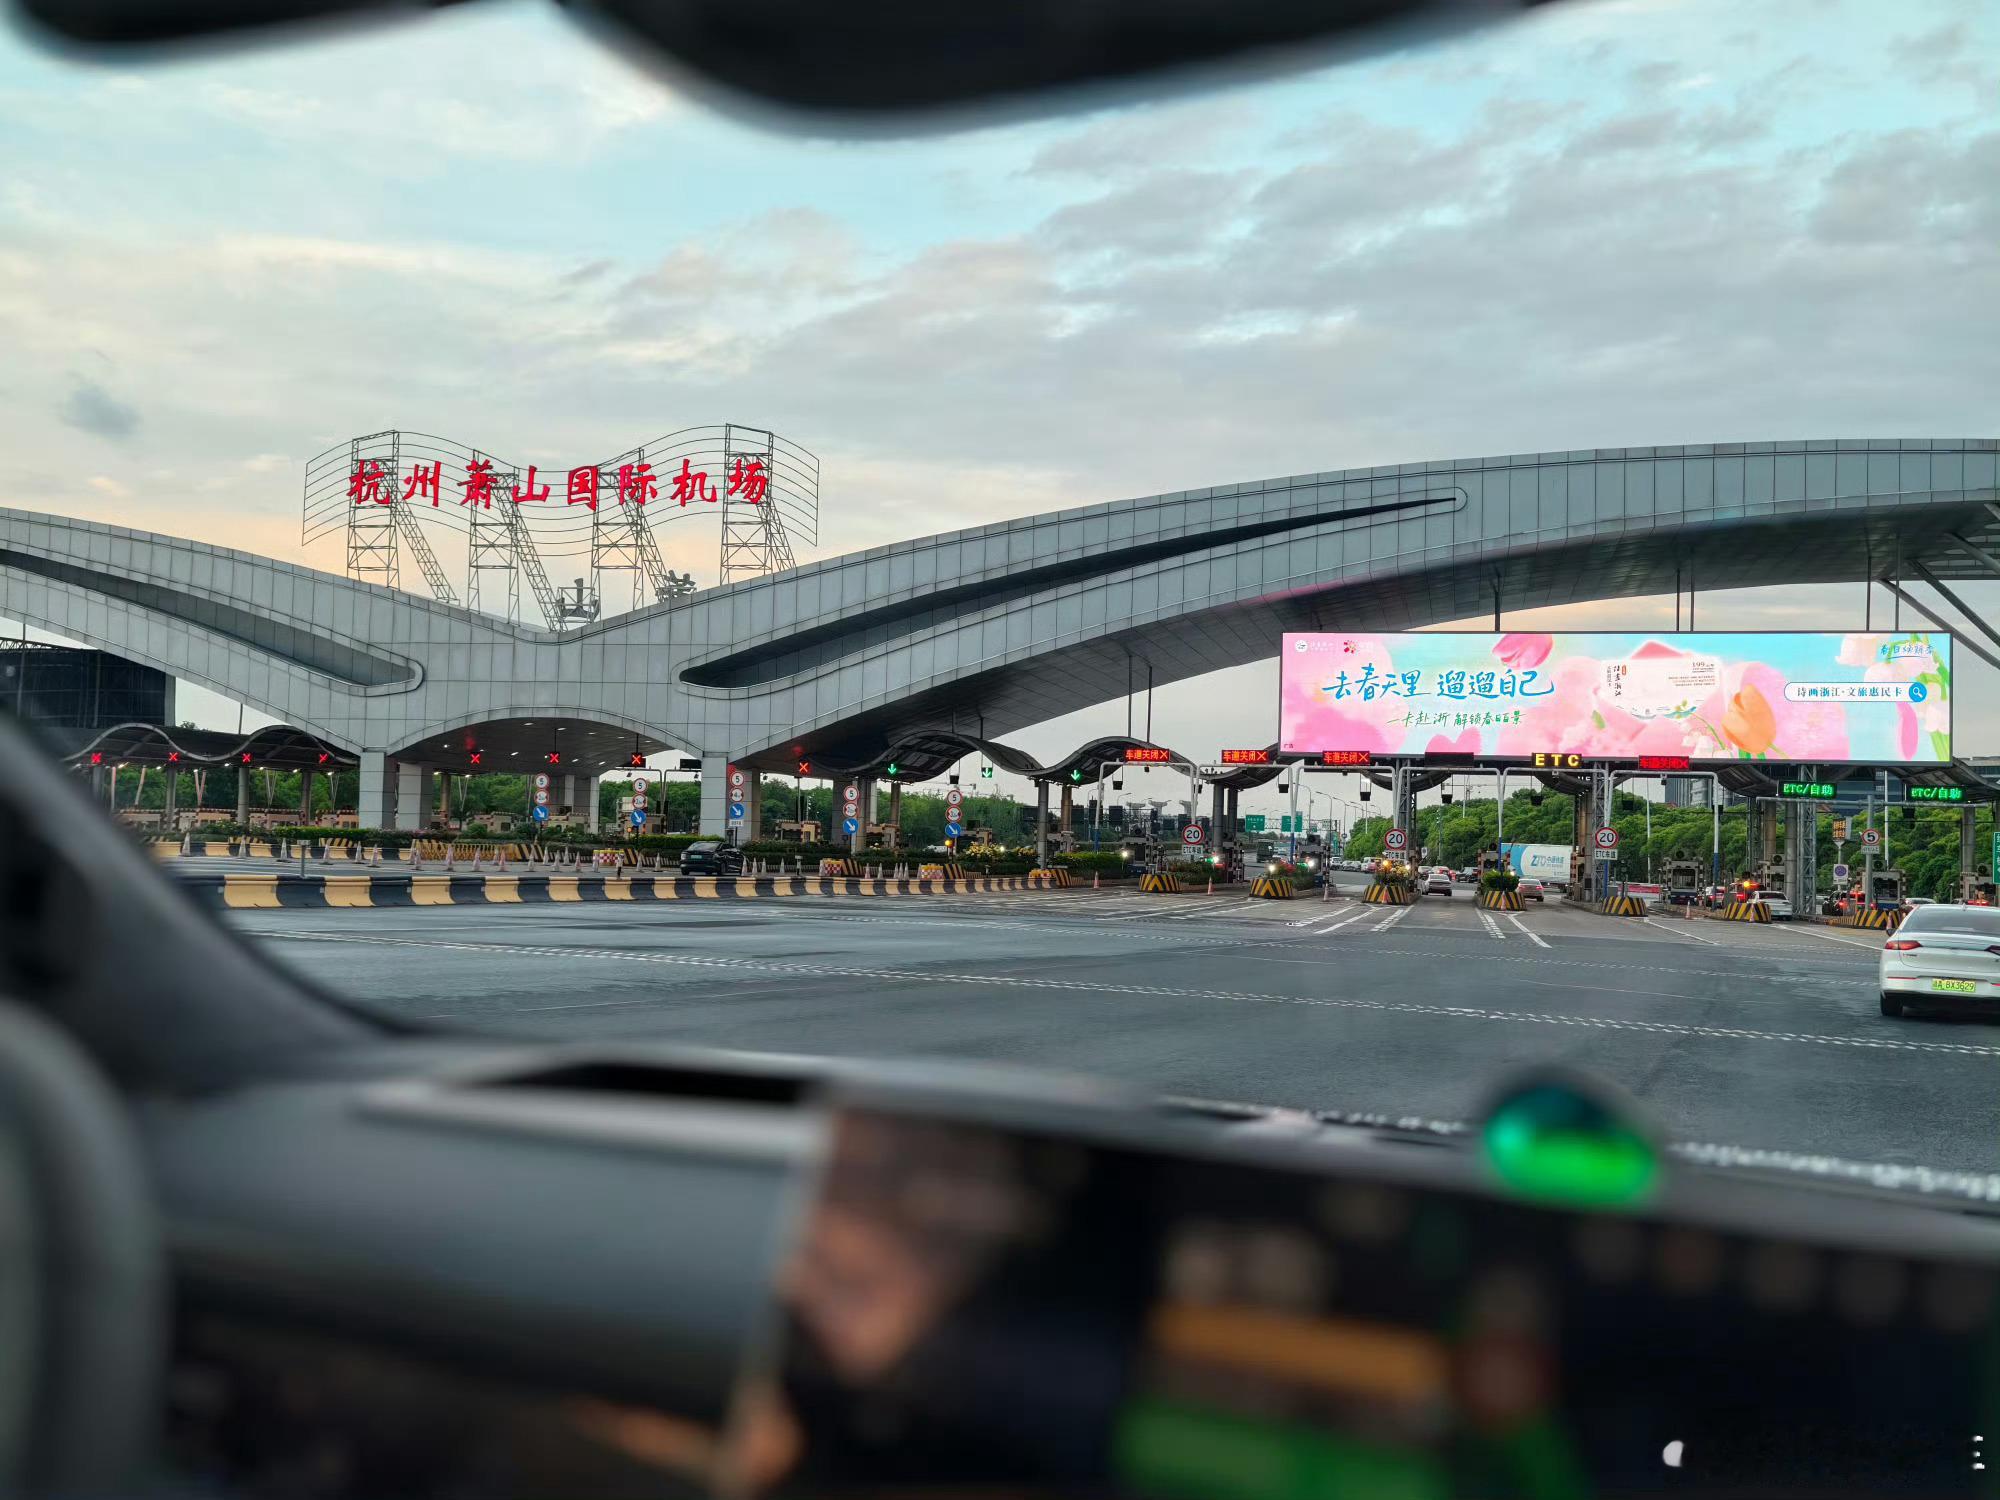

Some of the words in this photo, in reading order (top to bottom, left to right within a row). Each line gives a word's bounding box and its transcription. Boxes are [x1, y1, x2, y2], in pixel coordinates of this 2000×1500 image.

[348, 458, 769, 510] 杭州萧山国际机场
[1322, 663, 1432, 701] 去春天里
[1437, 669, 1555, 700] 遛遛自己
[1126, 749, 1158, 760] 车道关闭
[1223, 750, 1256, 762] 车道关闭
[1324, 752, 1358, 763] 车道关闭
[1535, 754, 1579, 767] ETC
[1783, 783, 1833, 797] ETC/自助
[1911, 787, 1962, 800] ETC/自助
[1186, 829, 1199, 838] 20
[1389, 833, 1403, 844] 20
[1600, 832, 1614, 842] 20
[1867, 832, 1876, 841] 5
